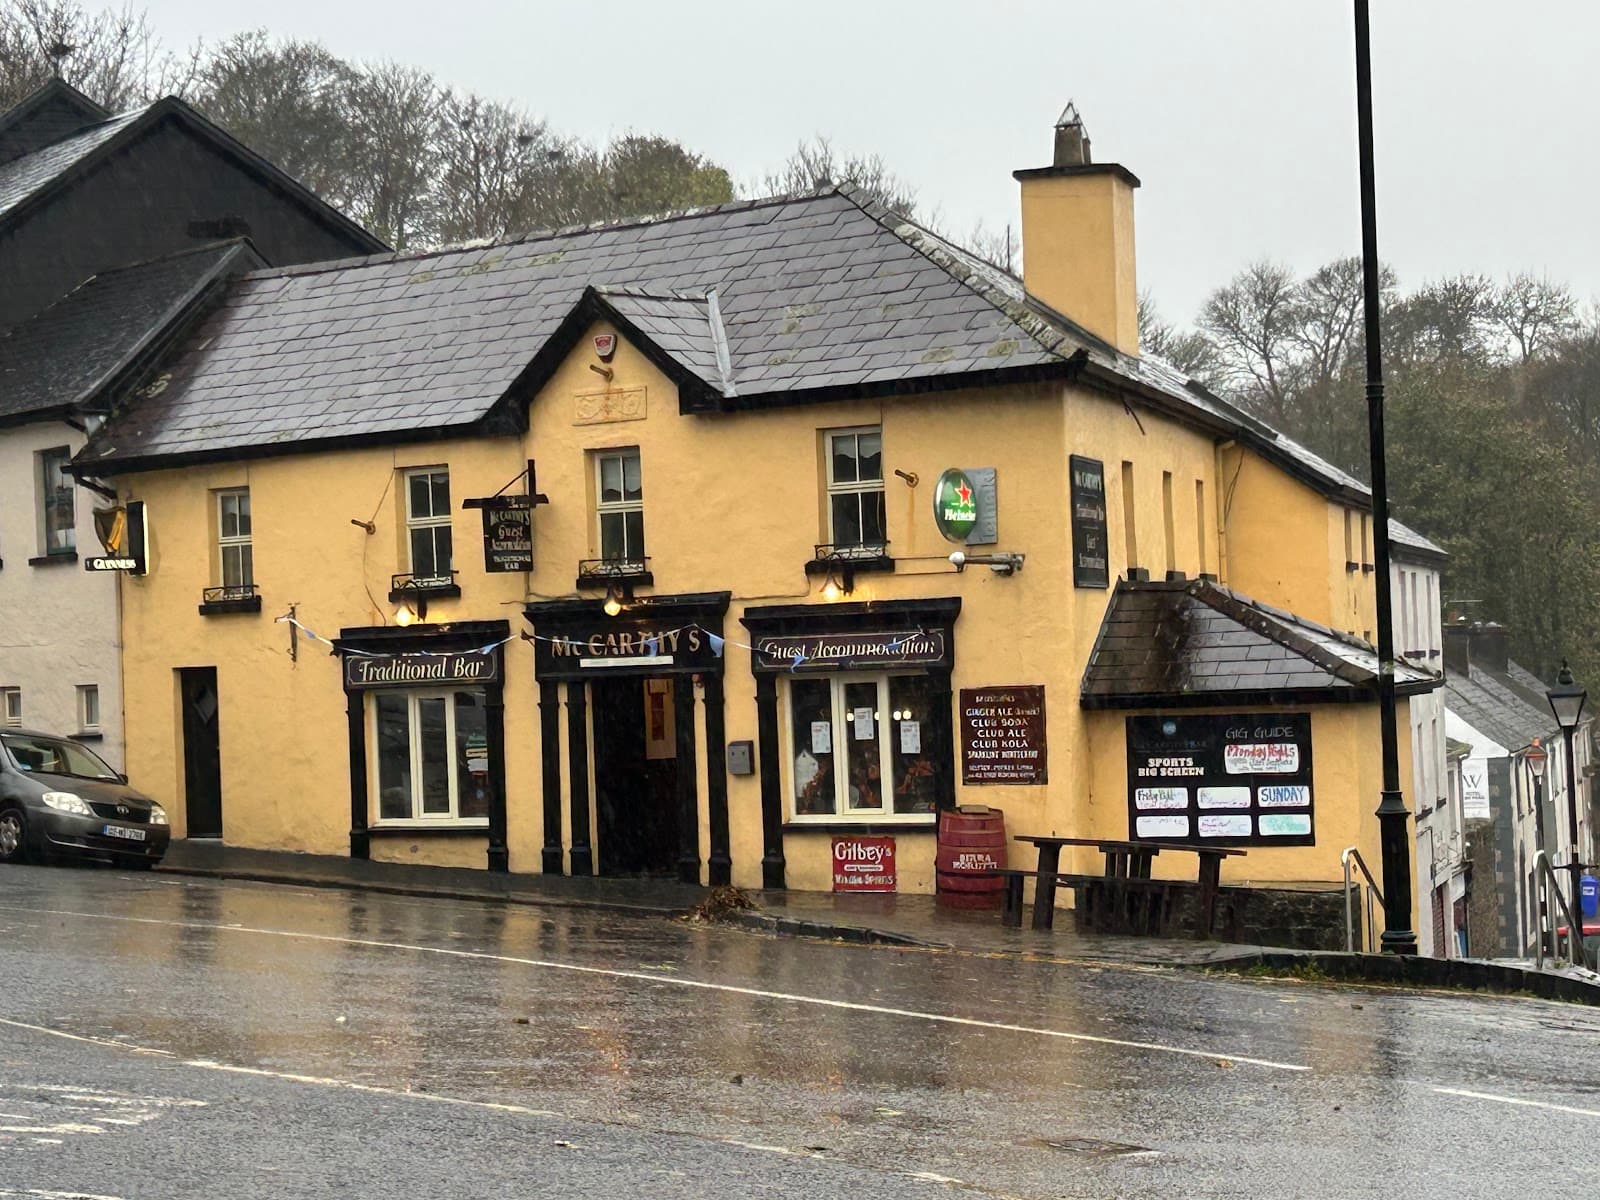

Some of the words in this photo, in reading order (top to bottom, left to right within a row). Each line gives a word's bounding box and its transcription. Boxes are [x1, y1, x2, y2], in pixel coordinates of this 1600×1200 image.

[764, 641, 806, 660] Guest
[809, 636, 935, 662] Accommodation
[359, 659, 447, 681] Traditional
[453, 656, 485, 677] Bar
[997, 707, 1013, 716] ALE
[1225, 727, 1249, 740] GIG
[1254, 726, 1295, 739] GUIDE
[1148, 757, 1194, 767] SPORTS
[1138, 767, 1158, 776] BIG
[1160, 766, 1205, 776] SCREEN
[1261, 787, 1304, 802] SUNDAY
